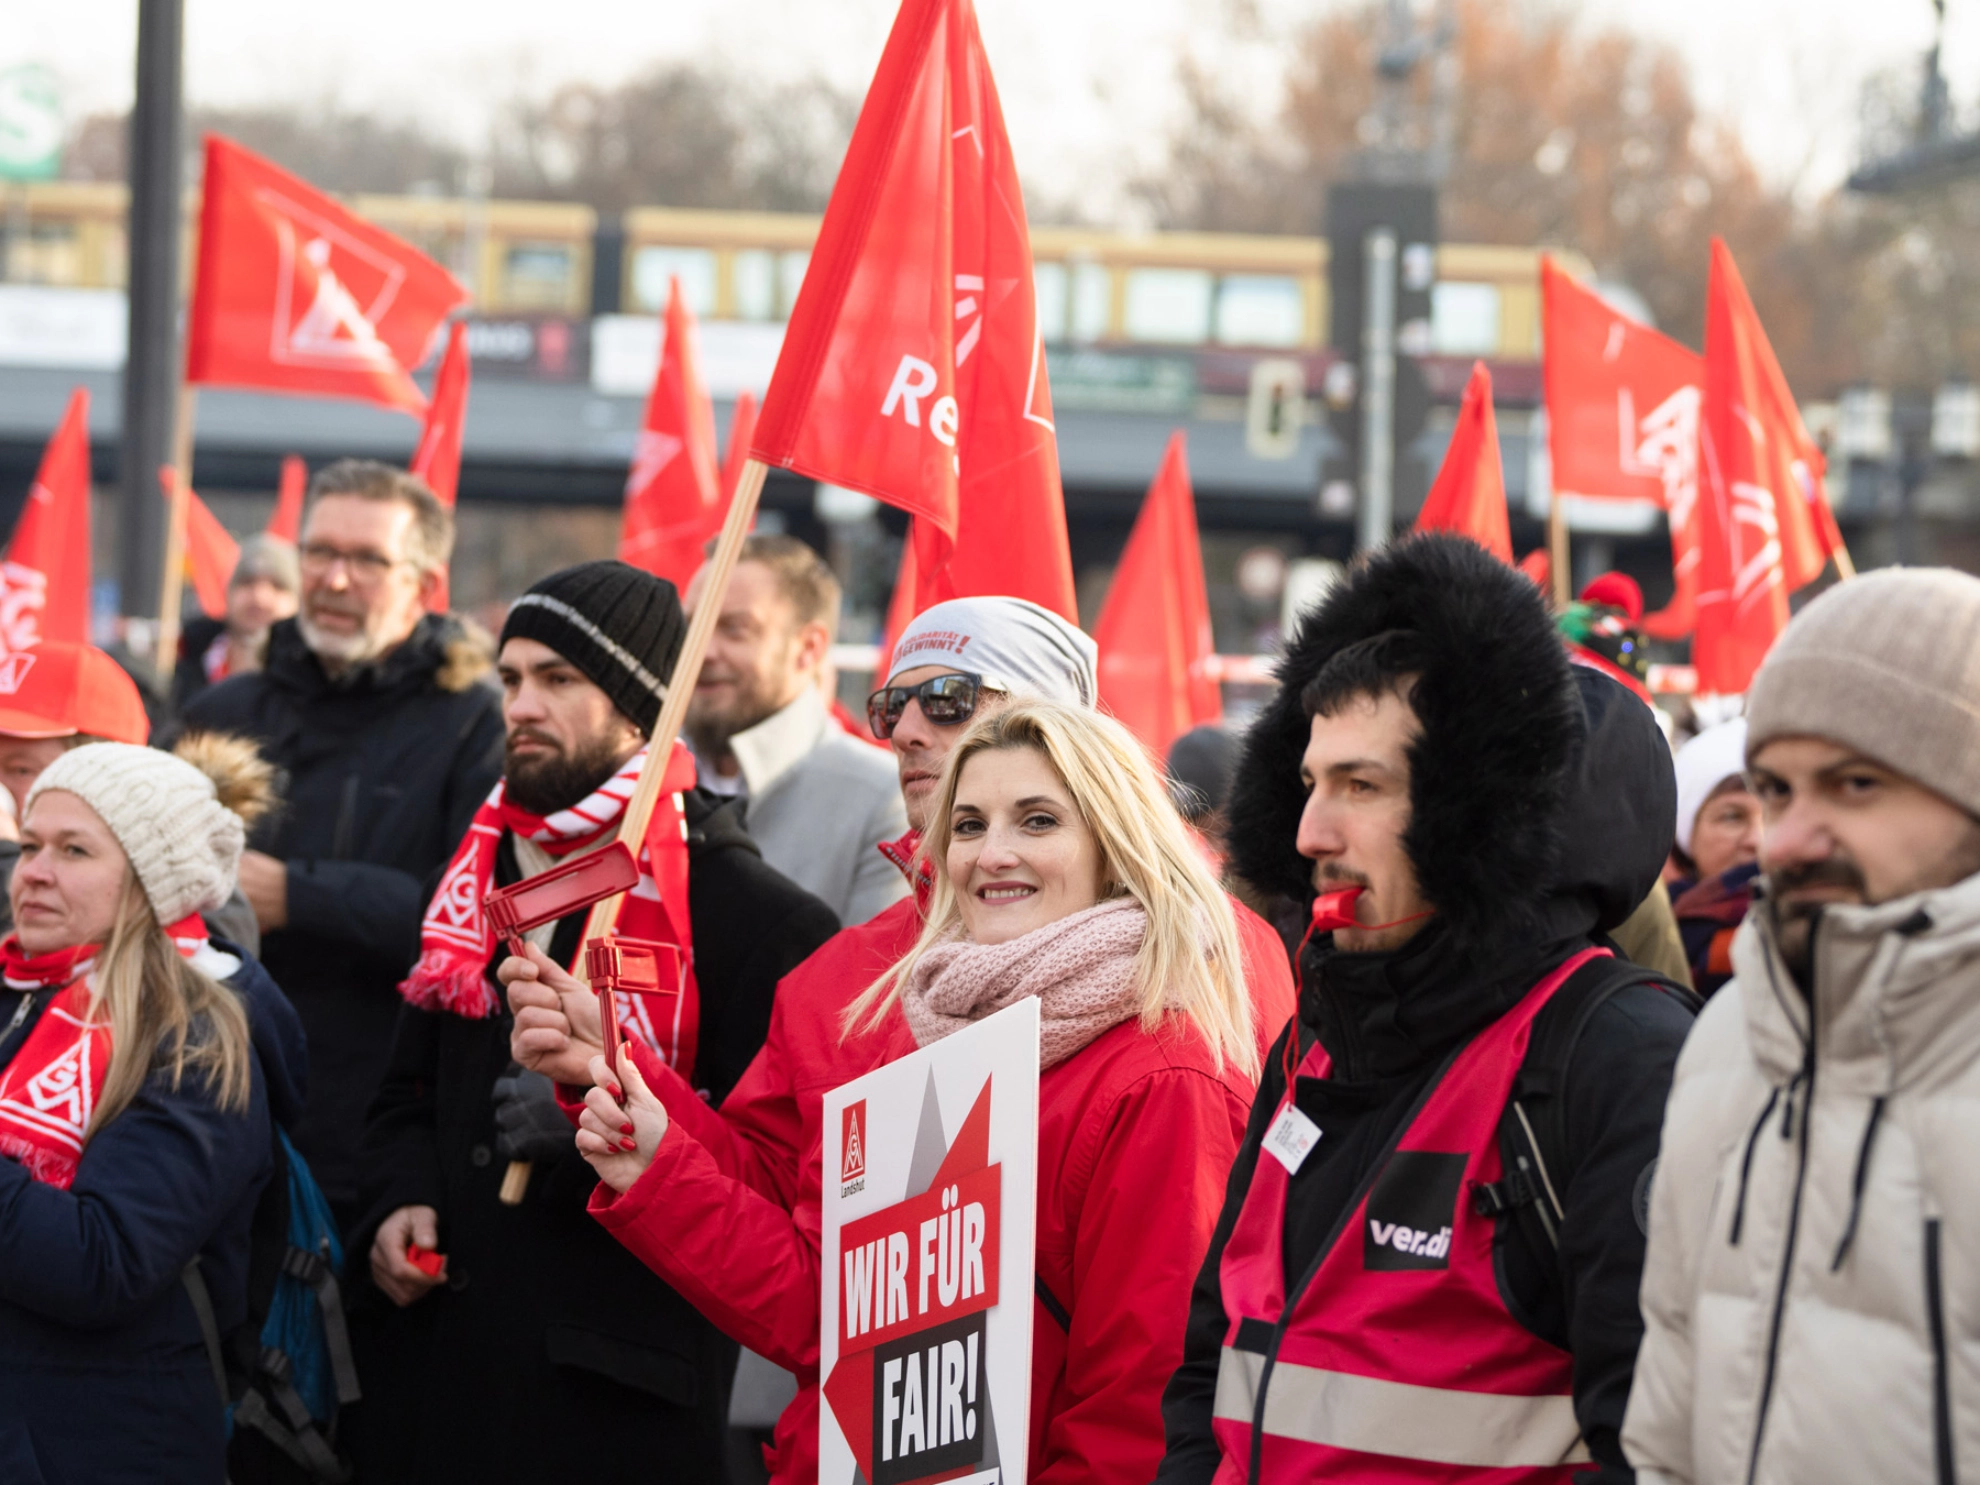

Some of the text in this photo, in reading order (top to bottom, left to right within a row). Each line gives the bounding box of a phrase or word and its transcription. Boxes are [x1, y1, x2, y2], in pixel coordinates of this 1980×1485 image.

[841, 1178, 865, 1199] Landshut
[844, 1184, 986, 1340] WIR FÜR
[1370, 1218, 1453, 1259] ver.di
[882, 1331, 980, 1463] FAIR!
